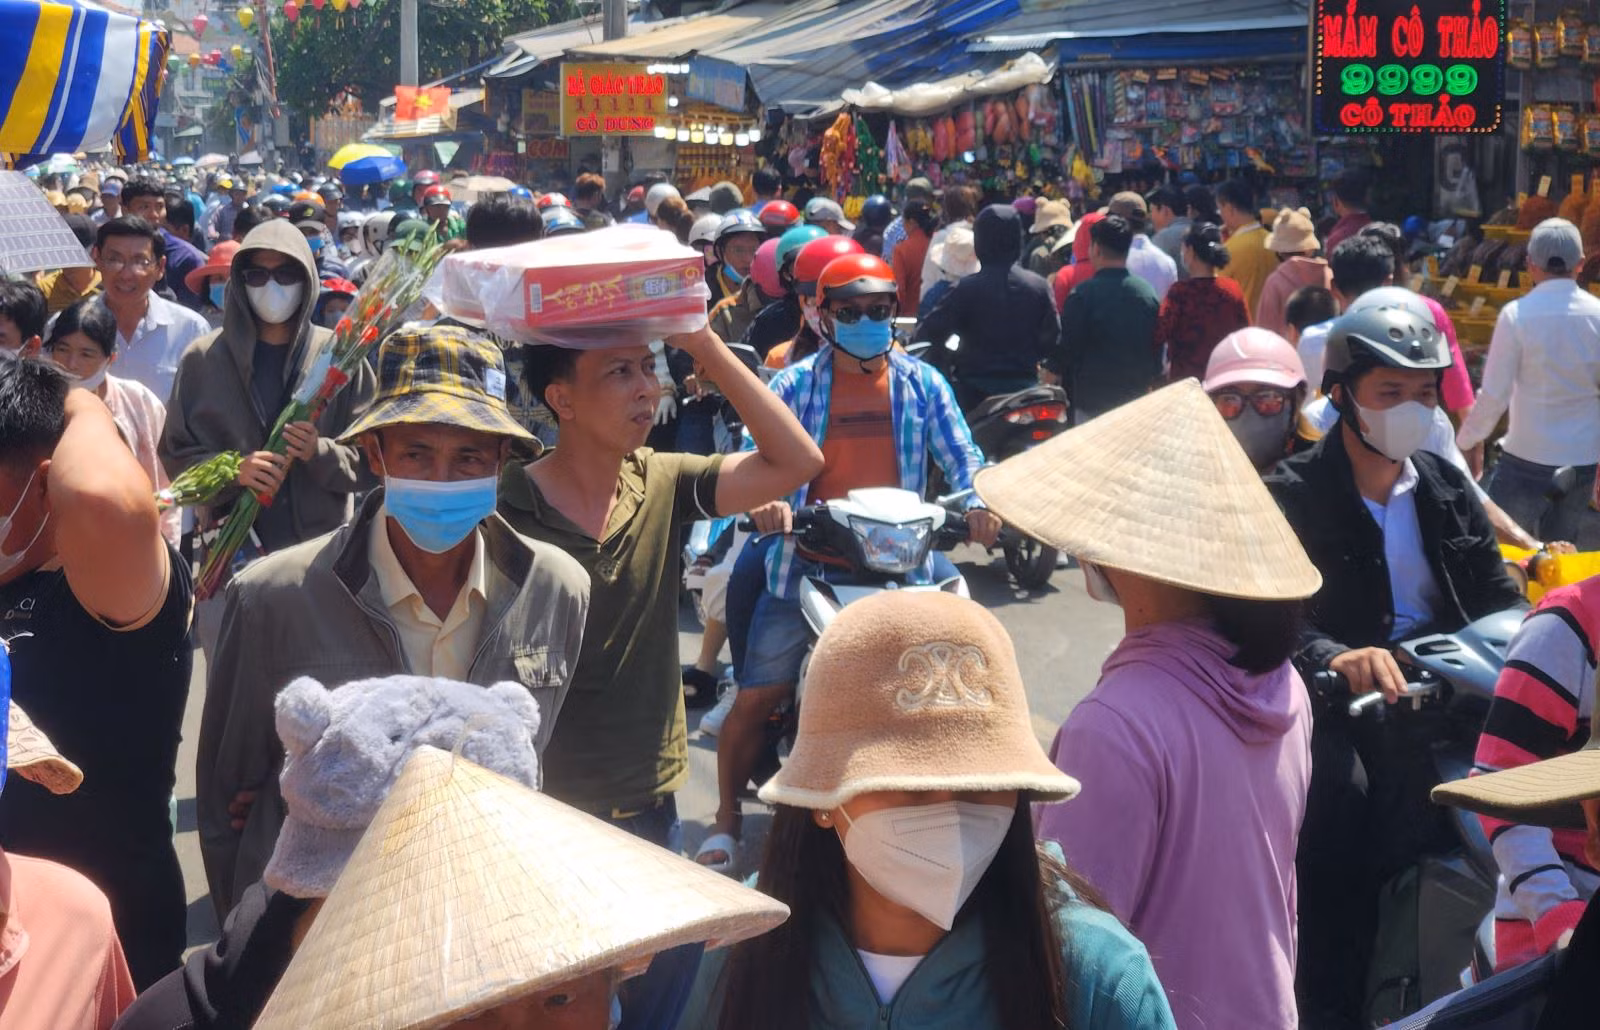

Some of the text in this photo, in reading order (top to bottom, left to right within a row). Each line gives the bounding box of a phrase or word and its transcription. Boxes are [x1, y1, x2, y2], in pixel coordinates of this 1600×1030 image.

[1391, 4, 1424, 58] CÔ
[1437, 0, 1499, 58] THẢO
[1340, 63, 1478, 96] 9999
[1340, 93, 1476, 127] CÔ THẢO
